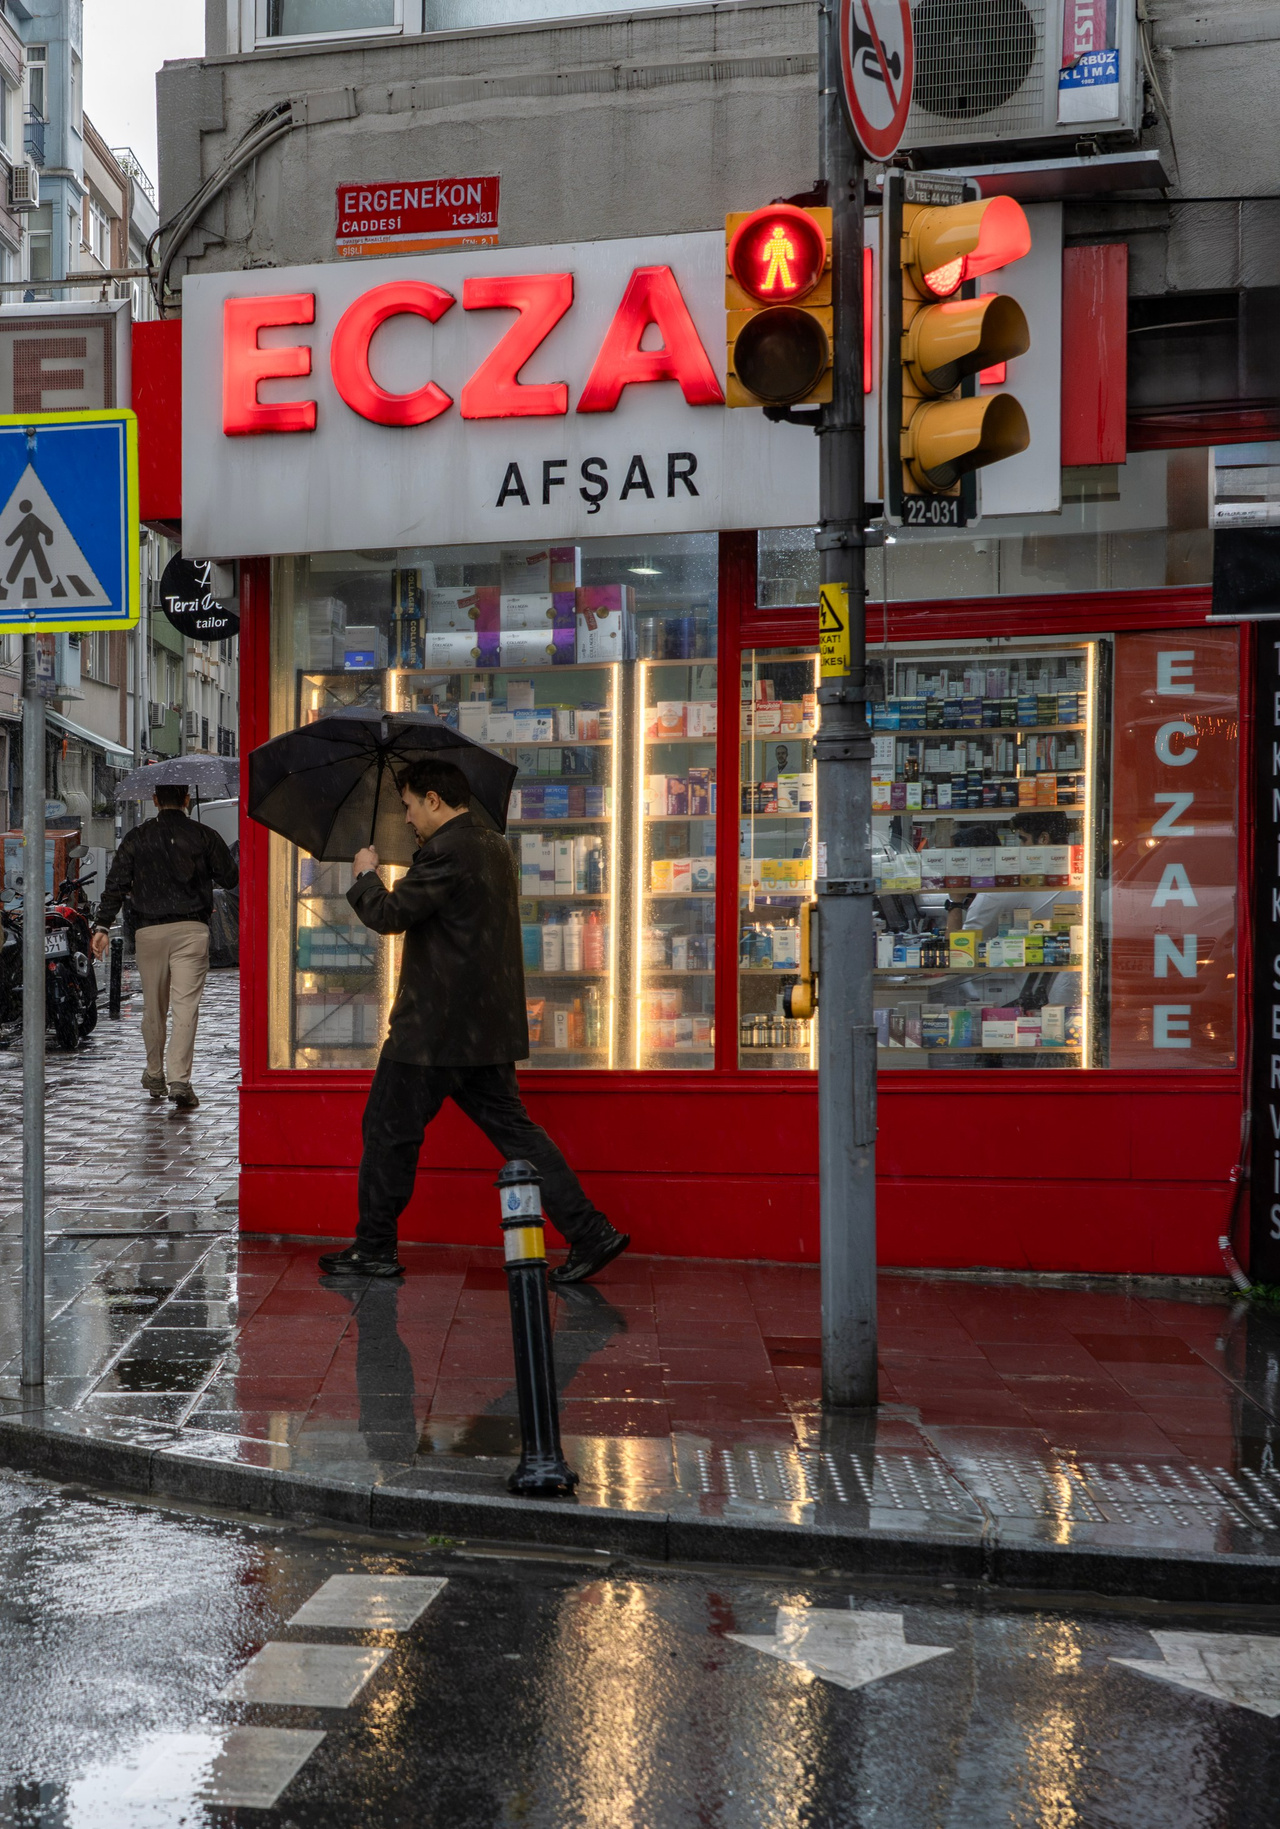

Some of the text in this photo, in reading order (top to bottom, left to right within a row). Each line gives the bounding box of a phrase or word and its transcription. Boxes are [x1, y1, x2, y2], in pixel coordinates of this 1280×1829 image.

[1060, 66, 1116, 80] KLİMA
[344, 183, 482, 214] ERGENEKON
[342, 216, 401, 233] CADDESİ
[342, 245, 363, 257] ŞİŞLİ
[495, 451, 700, 514] AFŞAR
[907, 500, 958, 523] 22-031
[165, 596, 199, 613] Terzi
[196, 616, 228, 629] tailor
[1151, 650, 1199, 1049] ECZANE
